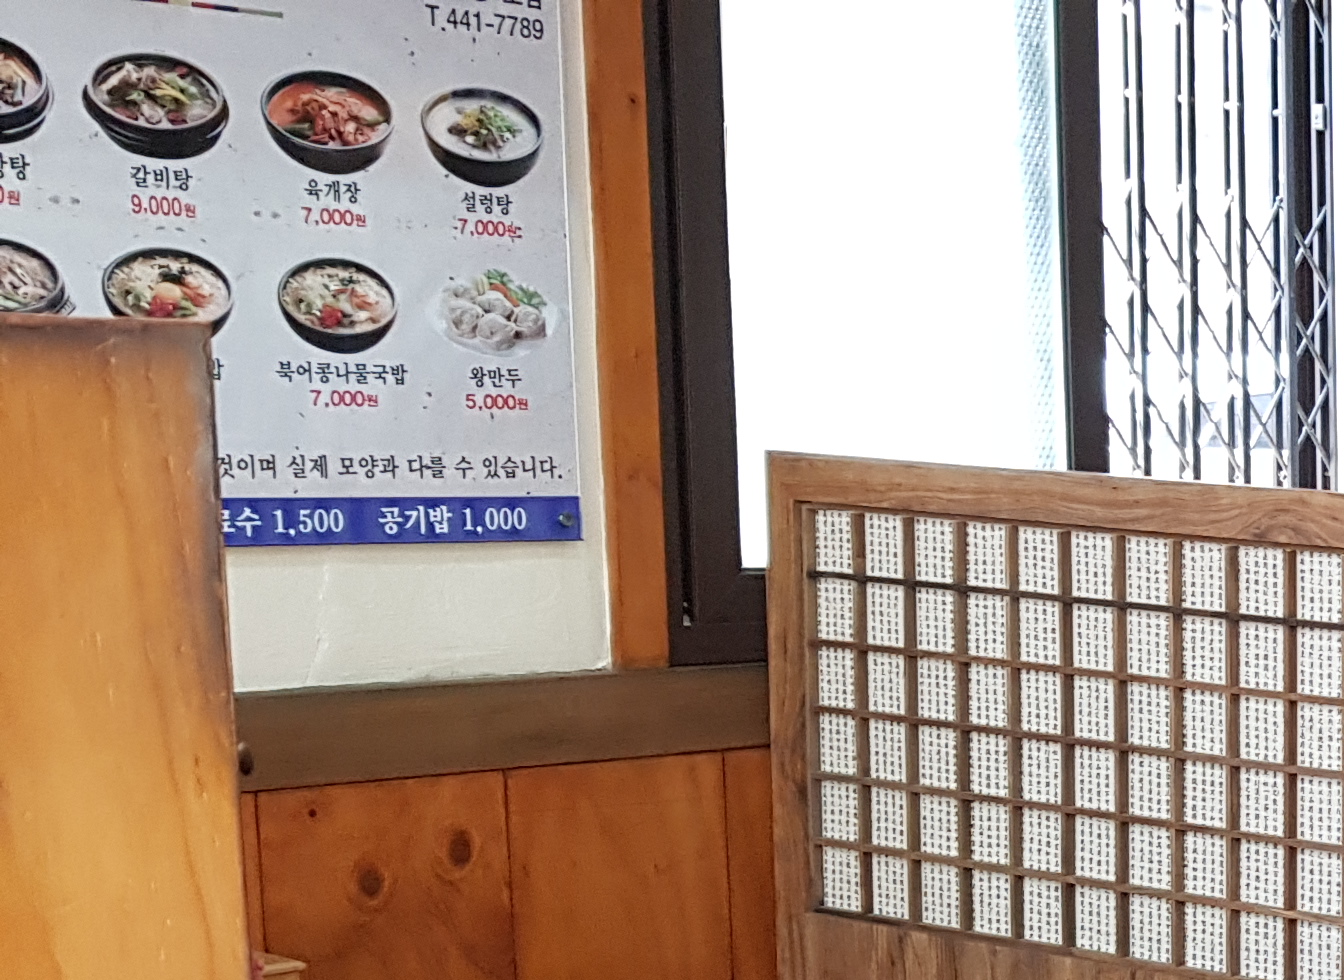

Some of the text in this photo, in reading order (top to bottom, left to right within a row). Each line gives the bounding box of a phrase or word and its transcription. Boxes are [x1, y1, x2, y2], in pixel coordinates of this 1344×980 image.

[425, 4, 544, 40] T.441-7789
[130, 164, 194, 192] 갈비탕
[303, 178, 362, 204] 육개장
[130, 193, 197, 219] 9,000원
[460, 191, 514, 216] 설렁탕
[301, 206, 367, 228] 7,000원
[274, 360, 409, 386] 북어콩나물국밥
[468, 366, 523, 389] 왕만두
[309, 389, 379, 408] 7,000원
[465, 393, 529, 411] 5,000원
[217, 454, 563, 480] 것이며 실제 모양과 다를 수 있습니다.
[271, 508, 345, 538] 1,500
[377, 505, 453, 535] 공기밥
[462, 507, 527, 536] 1,000
